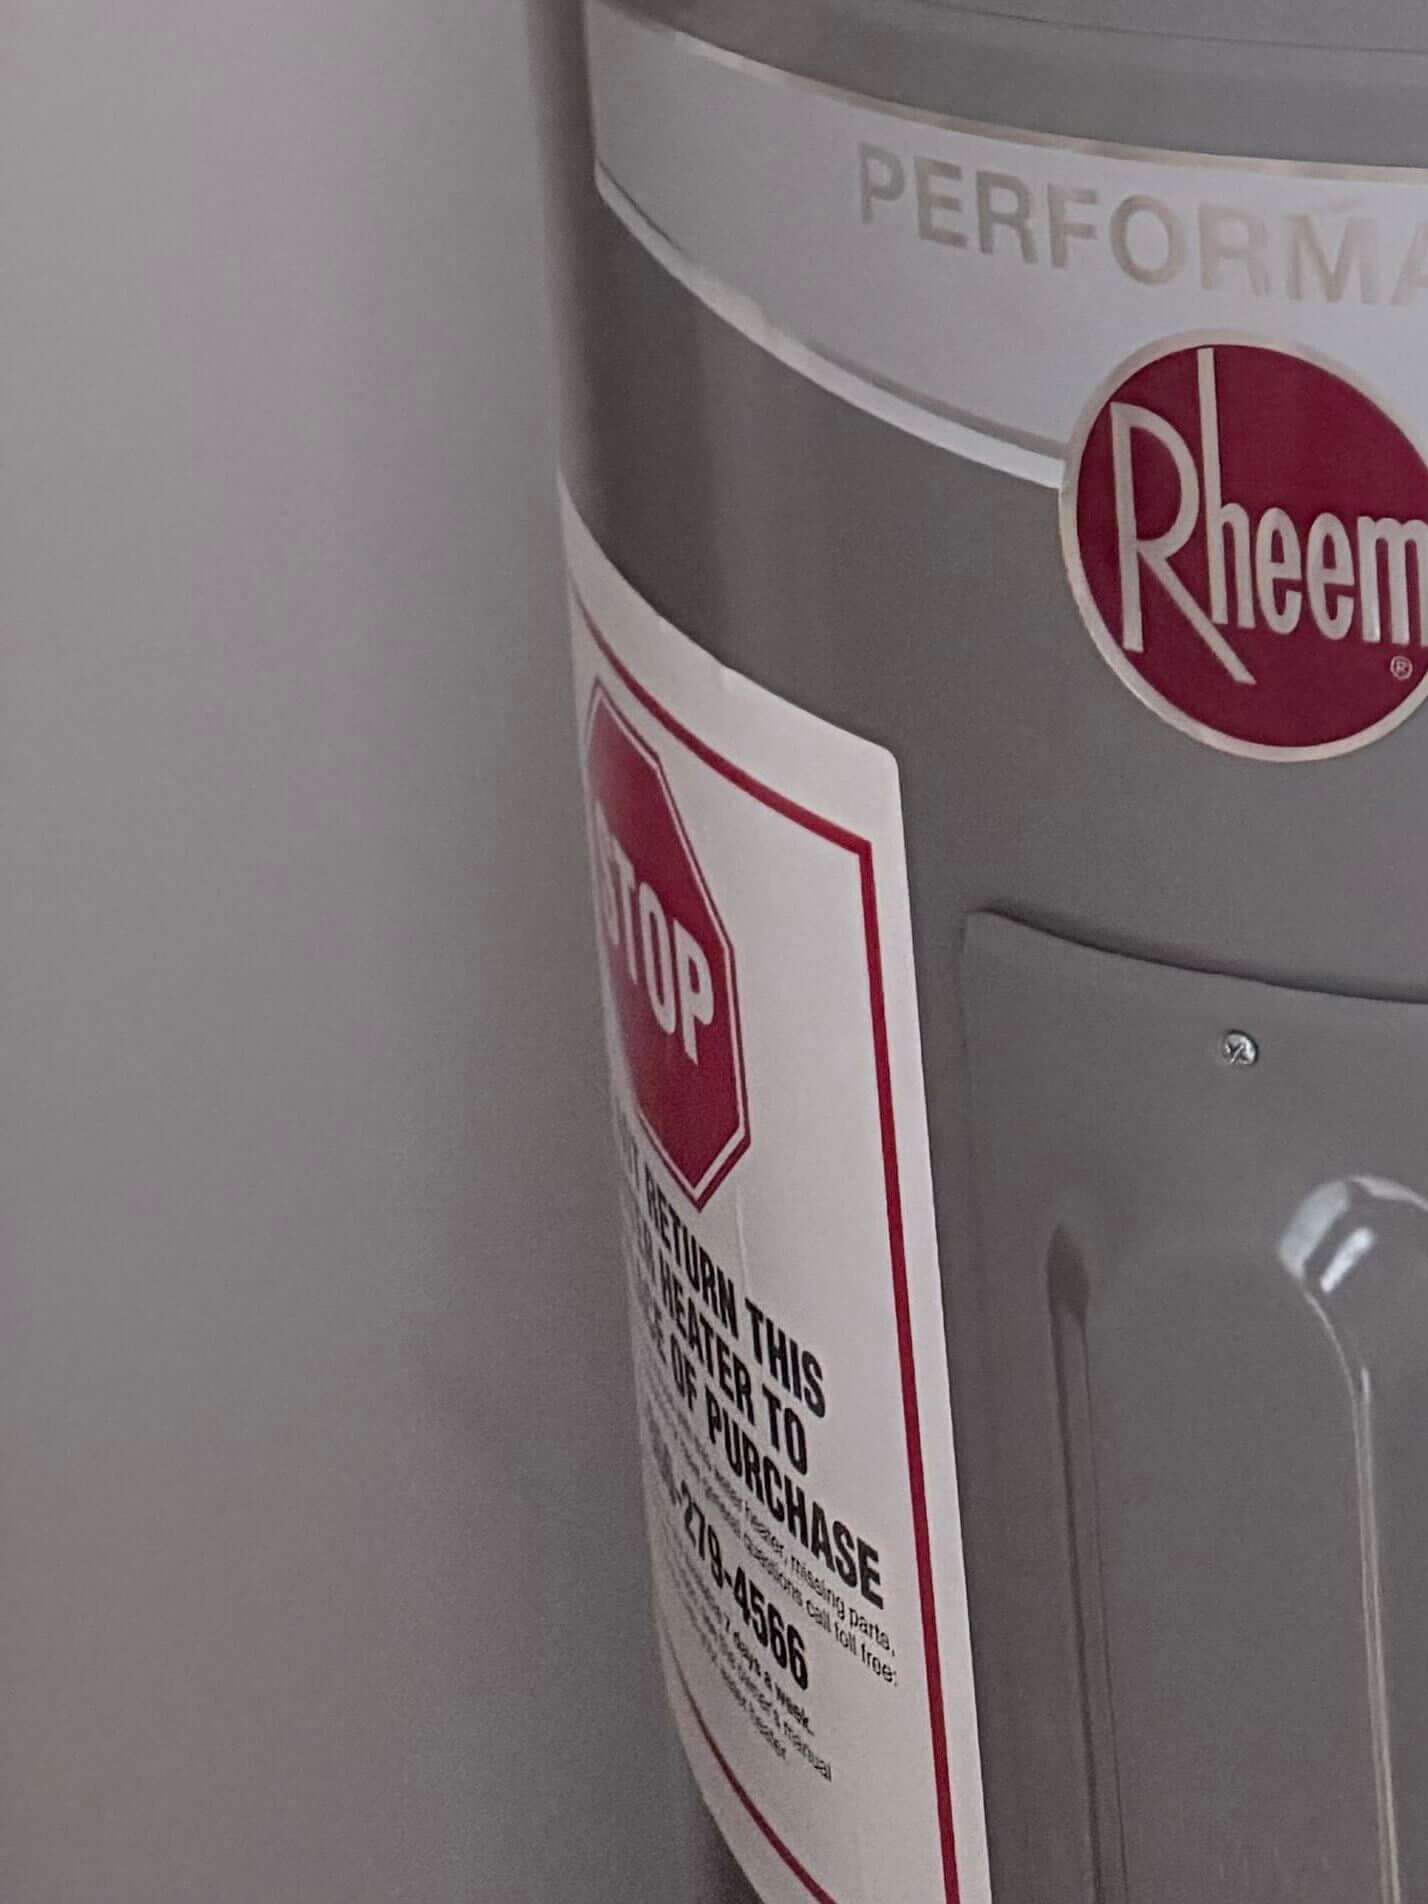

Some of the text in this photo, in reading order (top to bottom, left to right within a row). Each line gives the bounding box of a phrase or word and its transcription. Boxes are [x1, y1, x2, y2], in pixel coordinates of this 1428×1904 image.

[643, 1162, 739, 1339] RETURN
[744, 1297, 826, 1418] THIS
[658, 1248, 755, 1426] HEATER
[761, 1385, 808, 1476] TO
[670, 1333, 698, 1411] OF
[705, 1385, 884, 1610] PURCHASE
[848, 1609, 897, 1658] parts,
